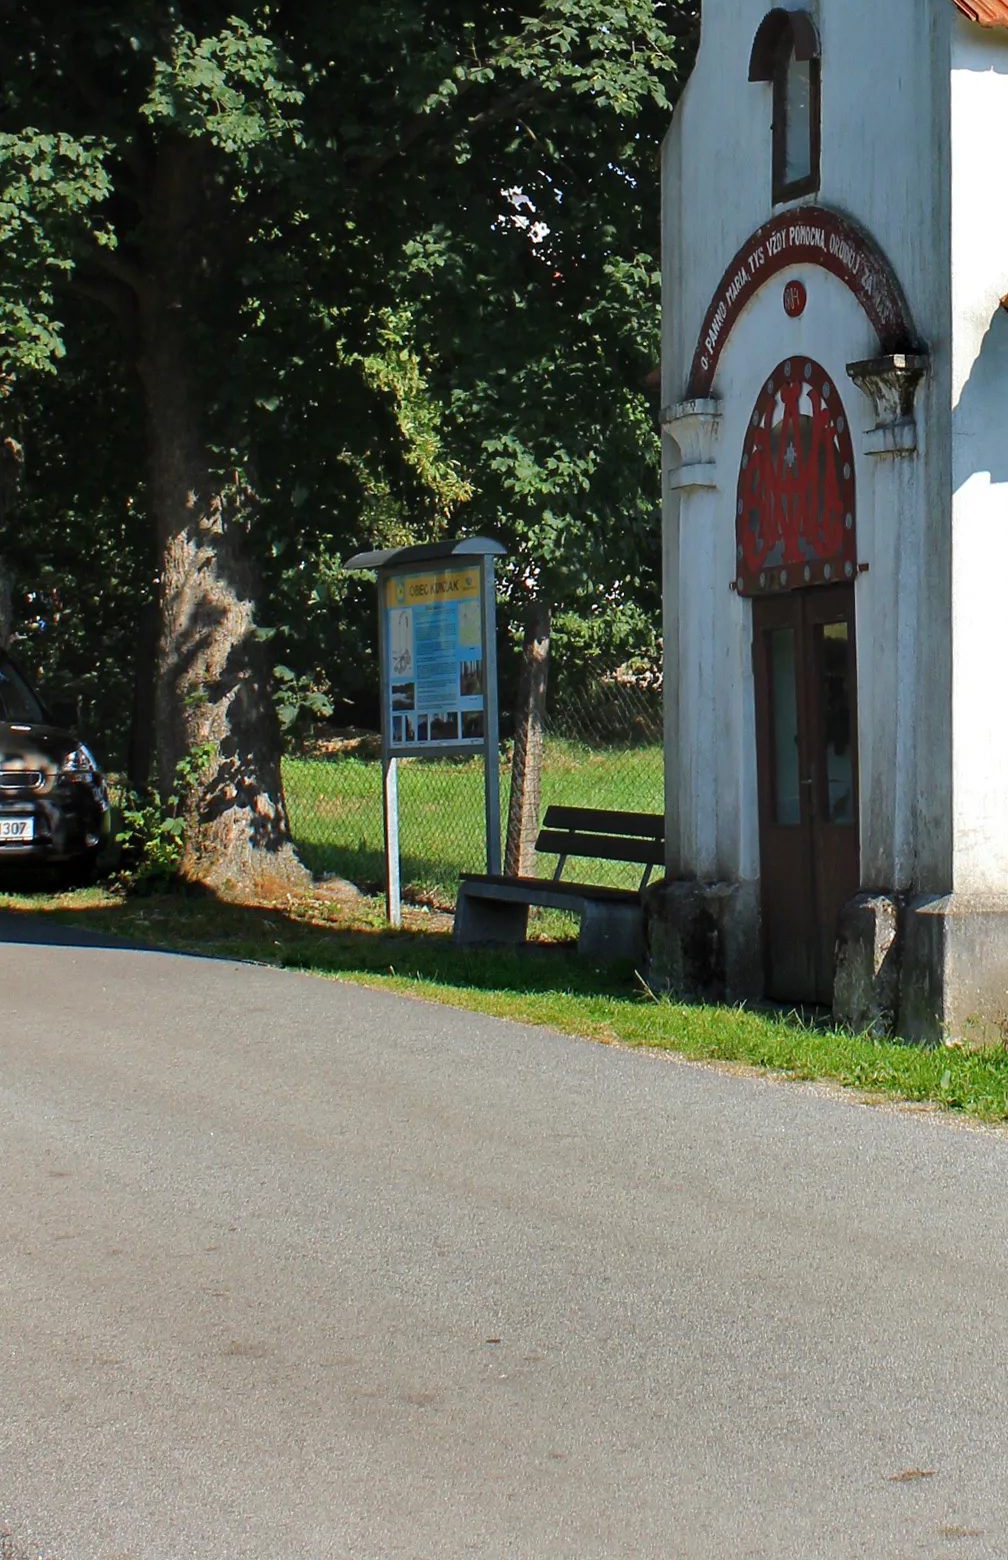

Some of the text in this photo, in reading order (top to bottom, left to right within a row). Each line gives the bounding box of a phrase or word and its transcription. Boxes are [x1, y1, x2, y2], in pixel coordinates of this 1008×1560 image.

[704, 301, 727, 355] PANNO
[748, 247, 765, 273] TYS
[766, 228, 787, 257] VŽDY
